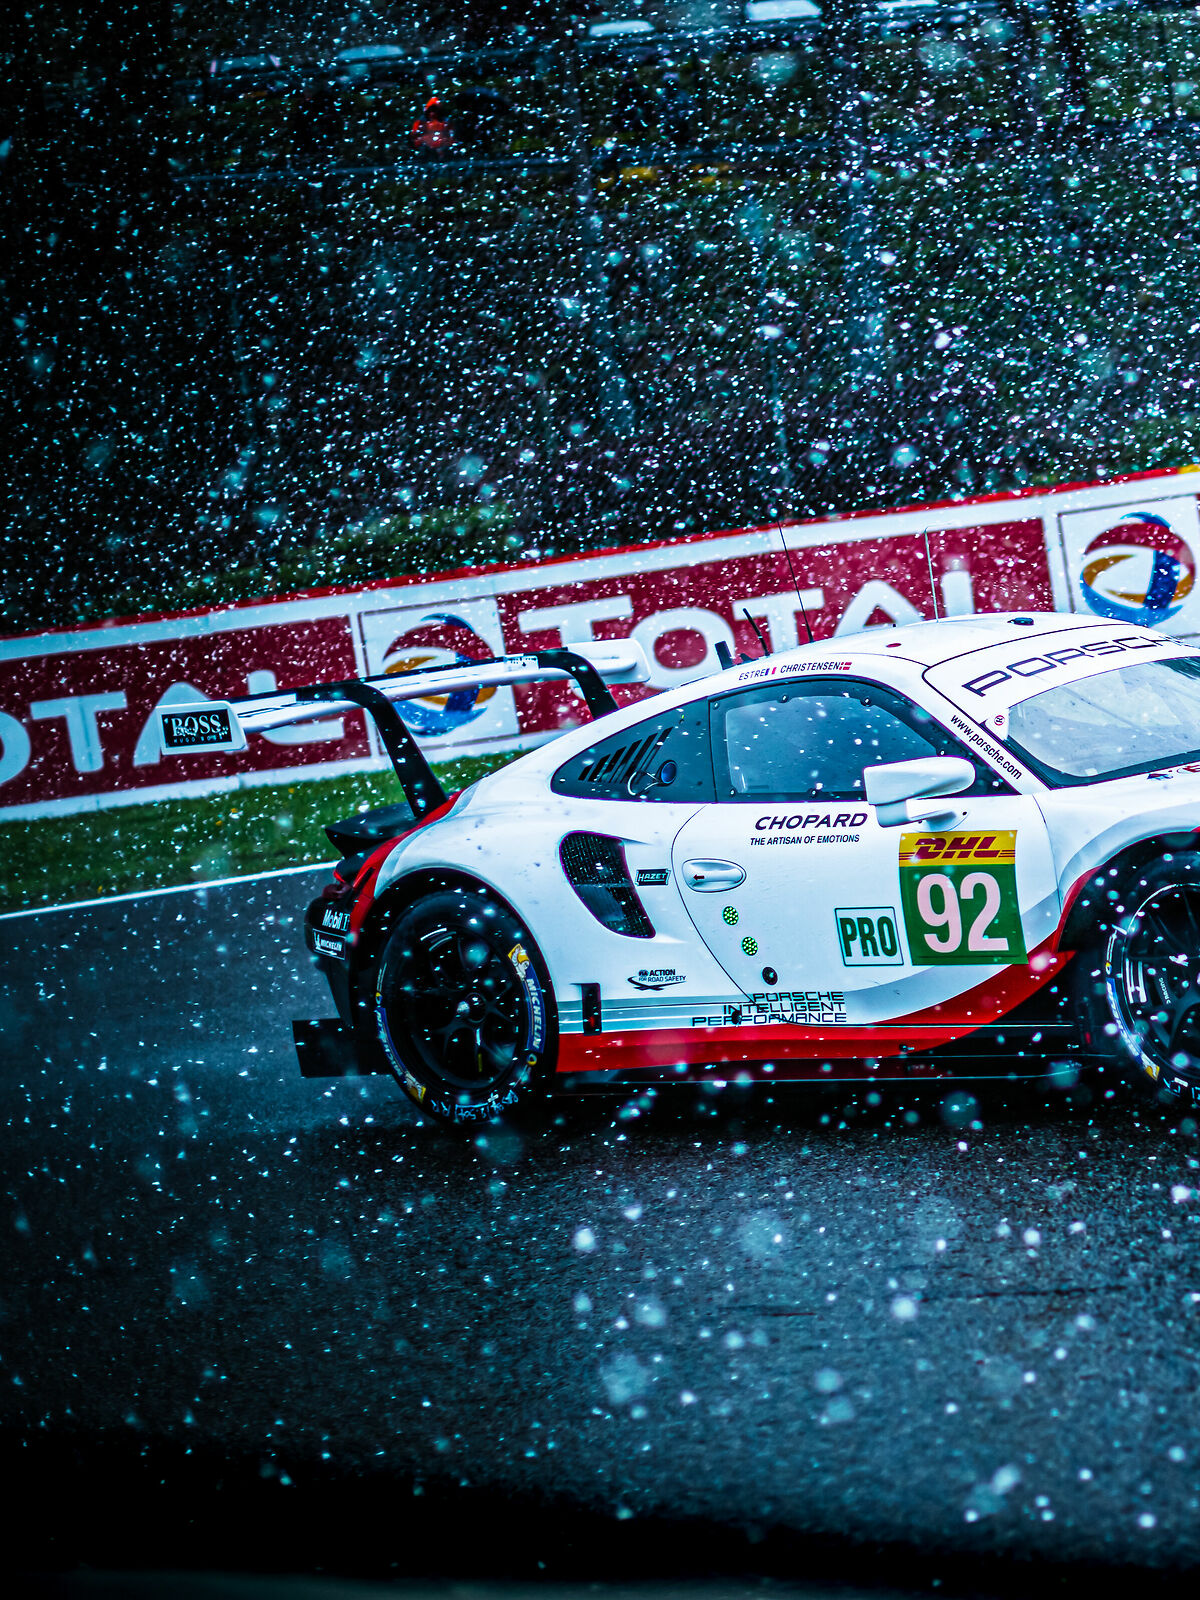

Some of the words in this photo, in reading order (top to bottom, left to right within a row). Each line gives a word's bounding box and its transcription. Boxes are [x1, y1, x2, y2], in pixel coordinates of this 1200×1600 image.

[780, 662, 840, 673] CHRISTENSEN
[171, 714, 222, 737] BOSS
[951, 715, 1022, 780] www.porsche.com
[755, 813, 868, 830] CHOPARD
[750, 837, 766, 846] THE
[767, 836, 803, 845] ARTISAN
[804, 835, 815, 844] OF
[817, 834, 860, 844] EMOTIONS
[914, 836, 1000, 860] DHL
[638, 873, 666, 881] HAZET
[917, 872, 1009, 953] 92
[839, 916, 898, 957] PRO
[752, 991, 845, 1002] PORSCHE
[527, 978, 544, 1050] MICHELIN
[723, 1002, 845, 1015] INTELLIGENT
[692, 1012, 847, 1027] PERFORMANCE
